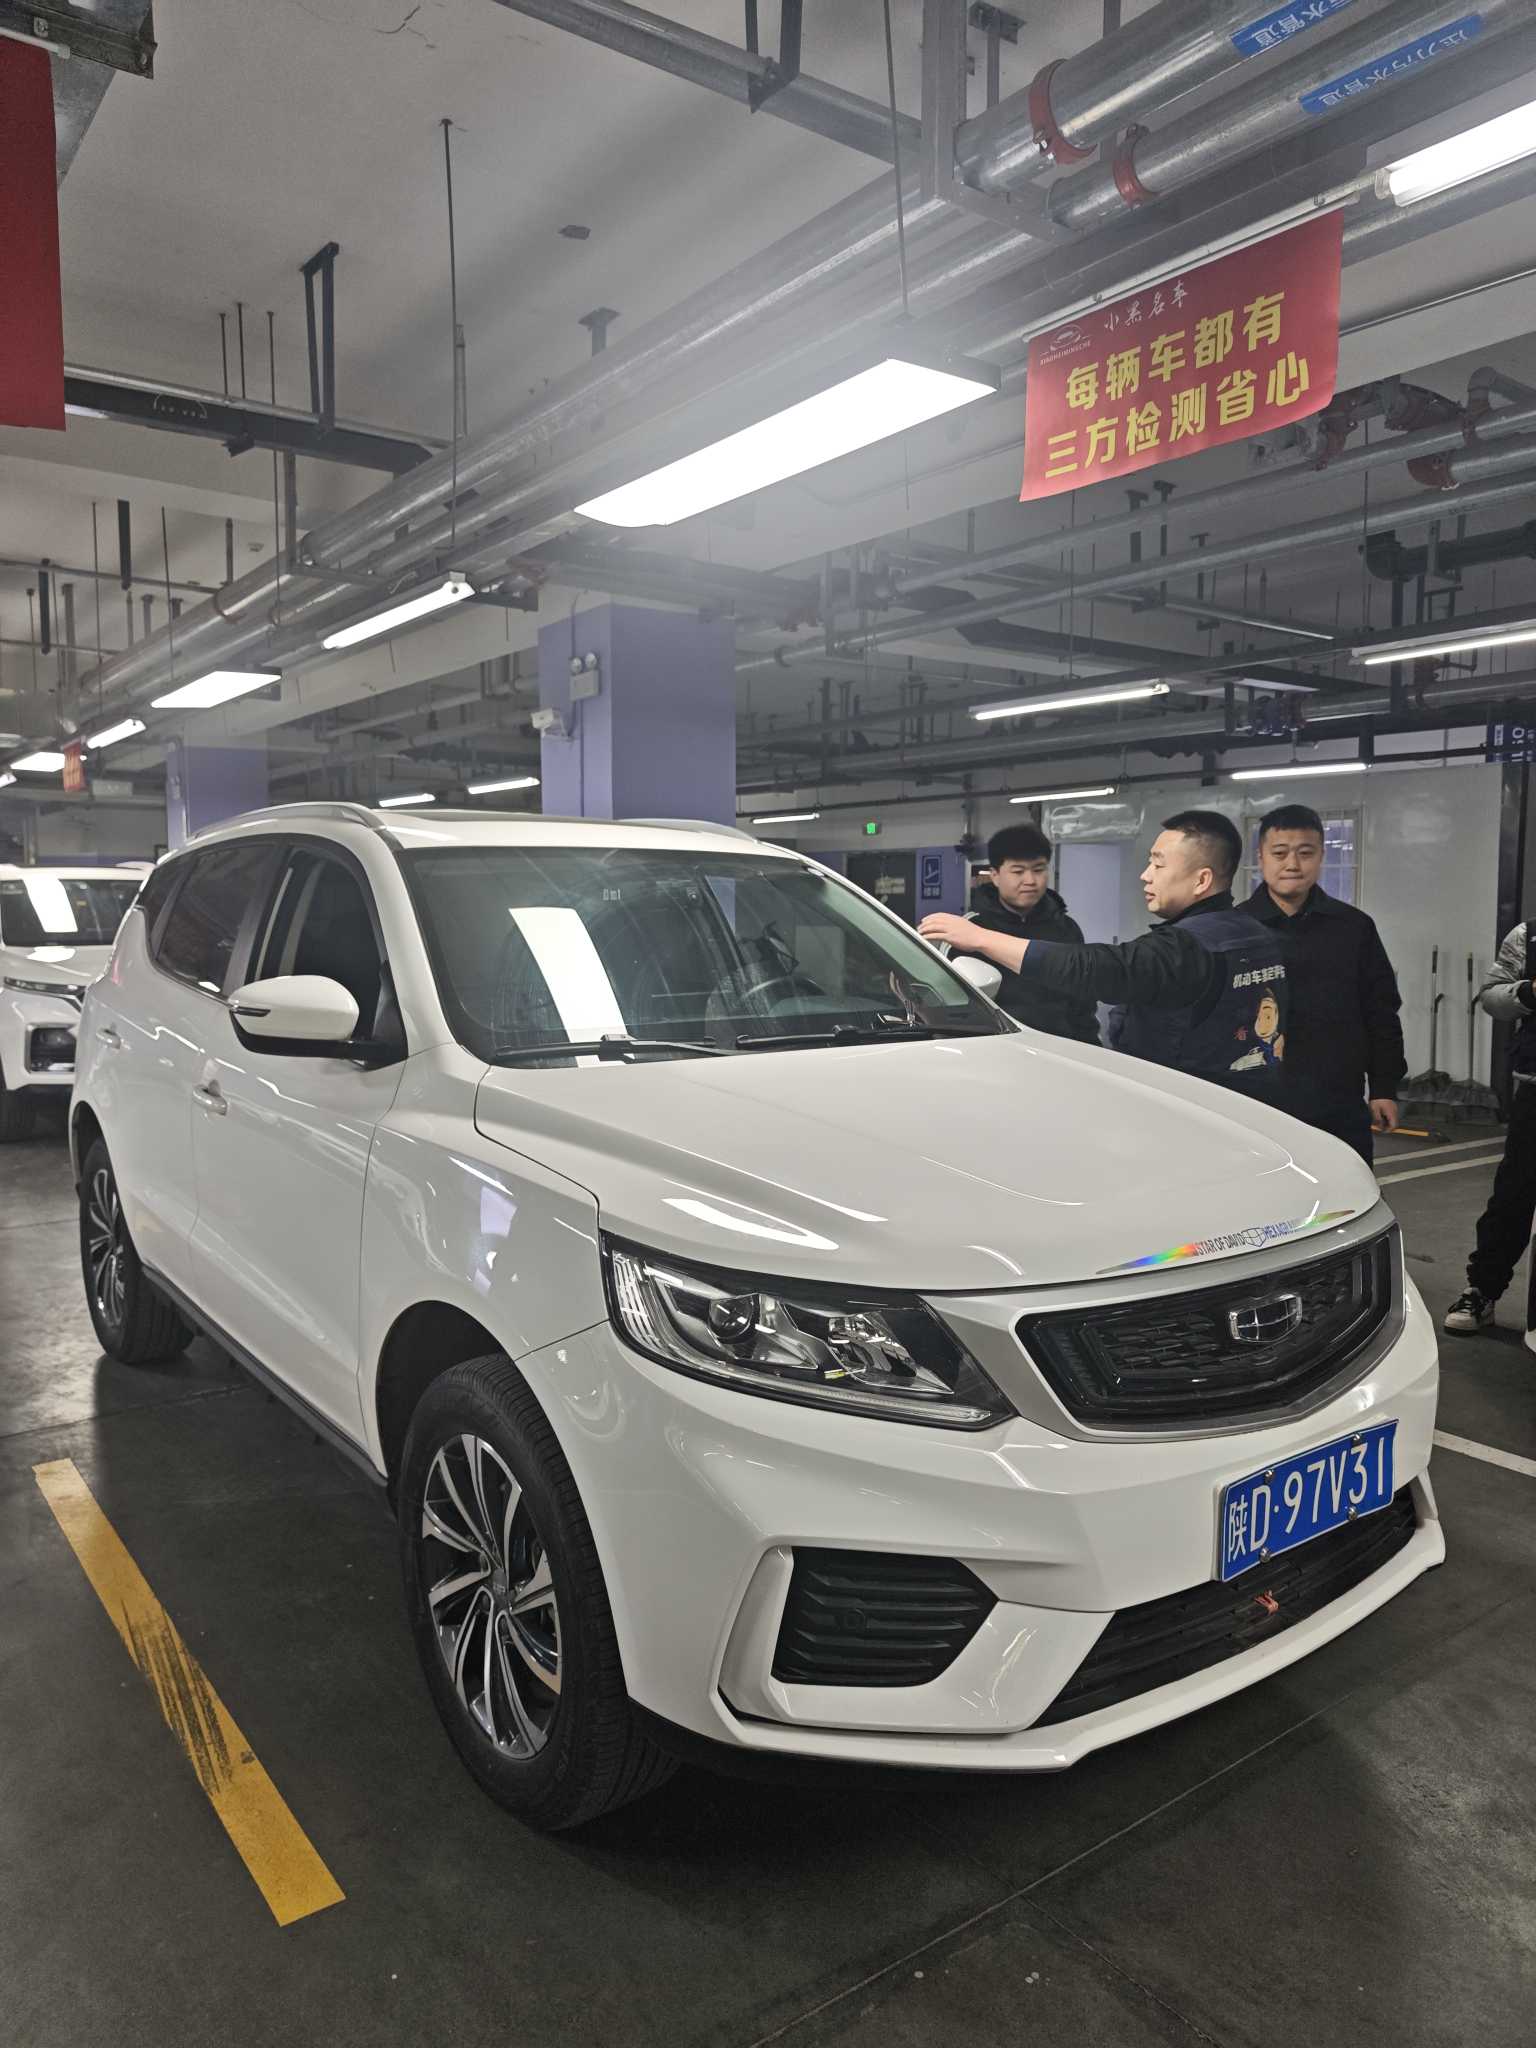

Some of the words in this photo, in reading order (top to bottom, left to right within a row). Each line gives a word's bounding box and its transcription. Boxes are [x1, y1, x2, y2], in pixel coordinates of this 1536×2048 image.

[1066, 292, 1285, 411] 每辆车都有
[1045, 351, 1310, 479] 三方检测省心
